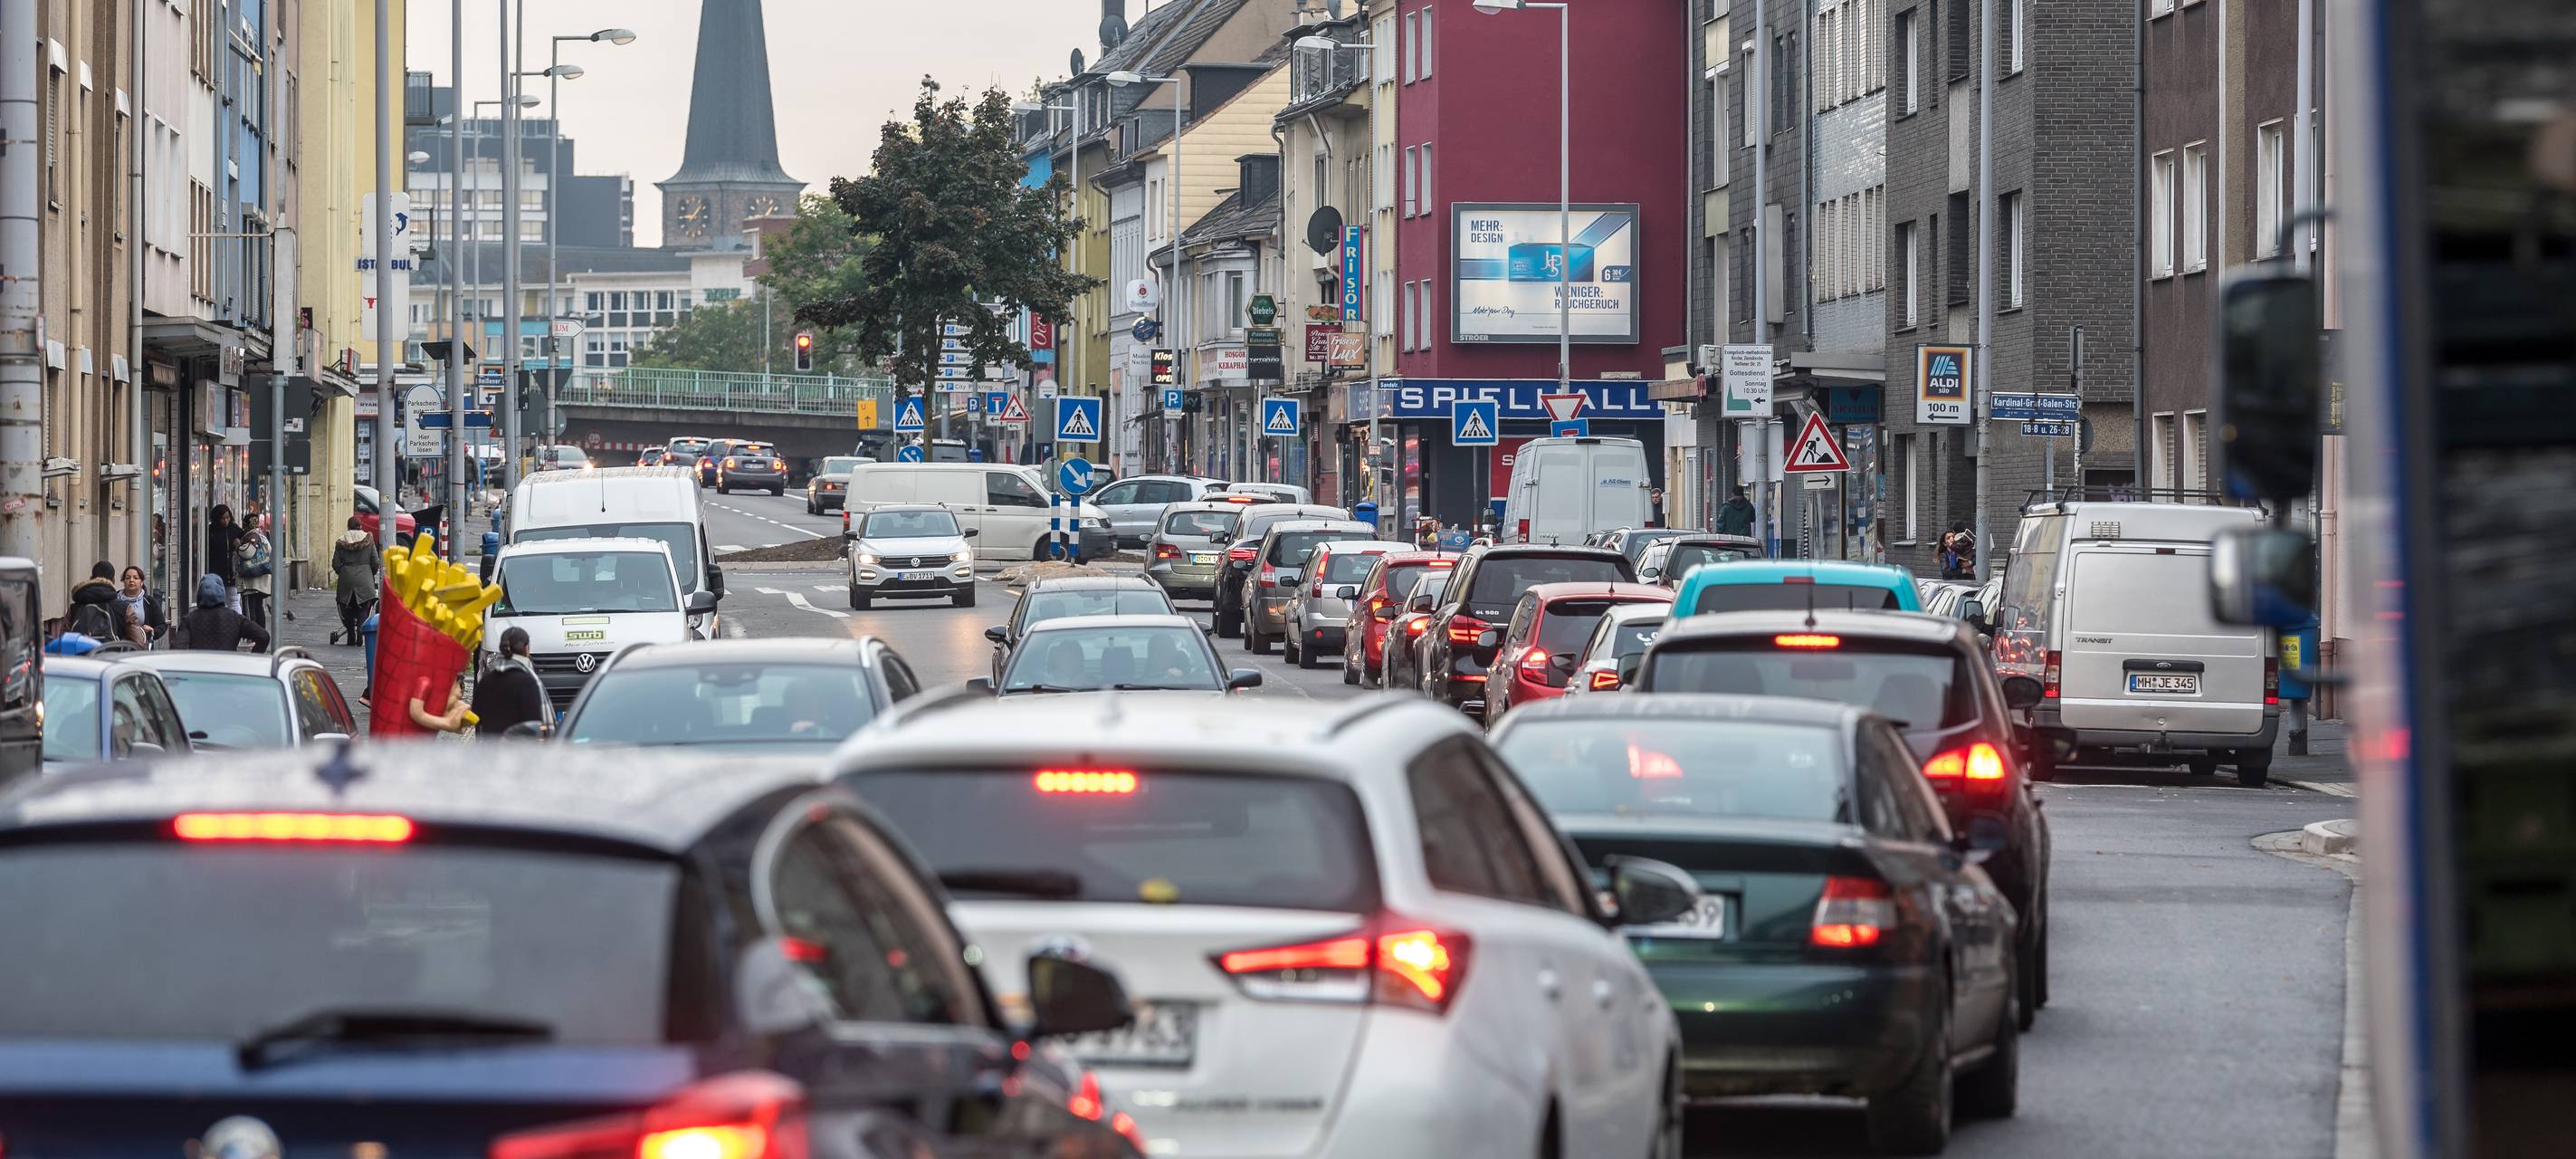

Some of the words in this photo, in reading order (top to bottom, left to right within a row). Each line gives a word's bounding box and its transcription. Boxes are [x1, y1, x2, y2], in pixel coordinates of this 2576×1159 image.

[1471, 220, 1503, 232] MEHR:
[1471, 233, 1503, 244] DESIGN
[358, 259, 413, 270] ISTBUL
[1554, 286, 1604, 298] WNIGER:
[1554, 299, 1619, 310] RUCHGERUCH
[1252, 306, 1274, 315] Diebels
[1154, 351, 1173, 360] Kios
[1331, 344, 1363, 361] Lux
[1929, 378, 1959, 388] ALDI
[1927, 403, 1946, 412] 100
[1949, 405, 1959, 413] m
[2137, 677, 2151, 688] MH
[2158, 678, 2172, 688] JE
[2174, 678, 2194, 688] 345
